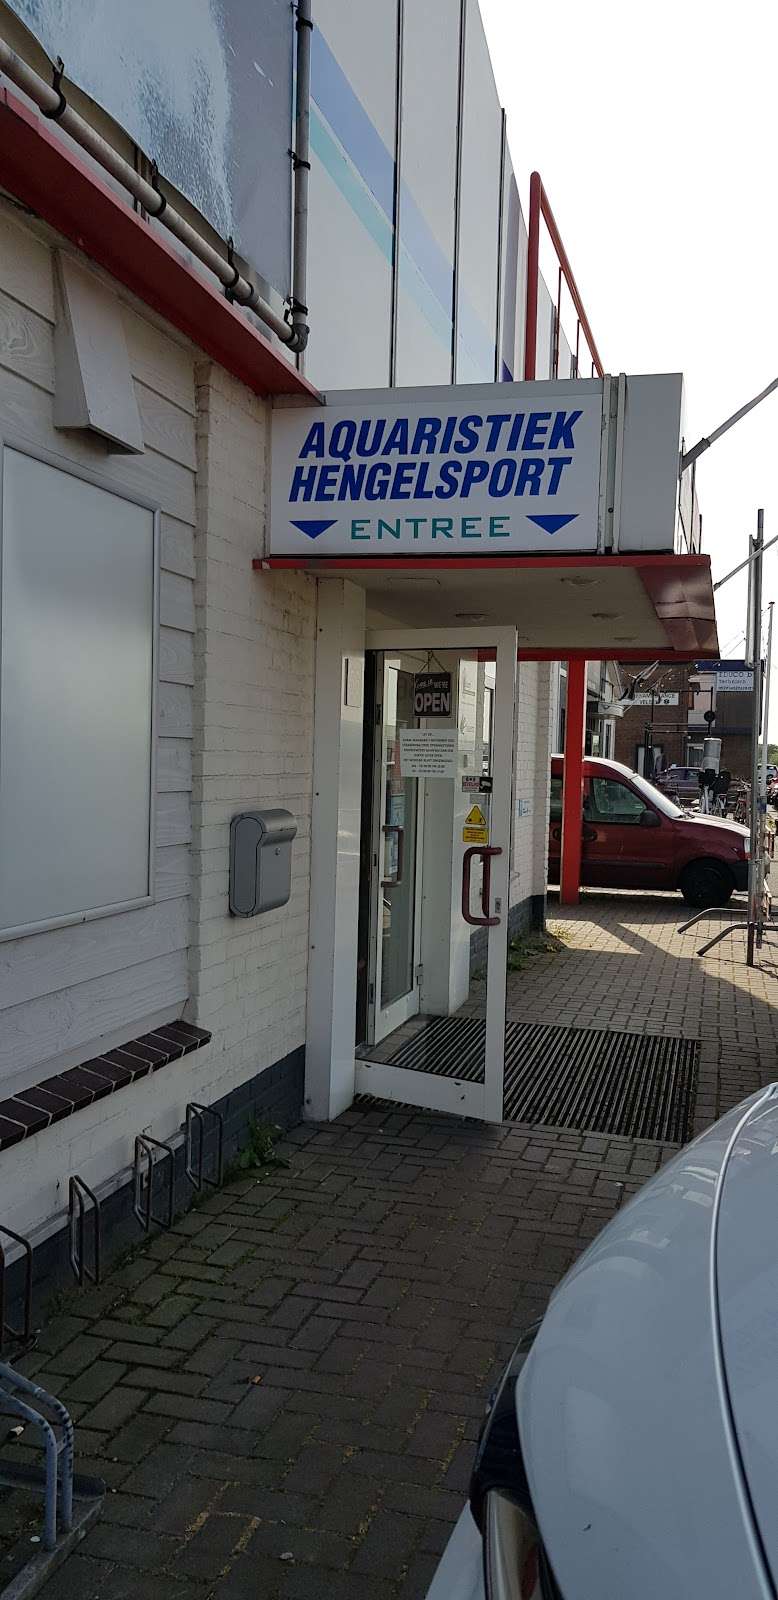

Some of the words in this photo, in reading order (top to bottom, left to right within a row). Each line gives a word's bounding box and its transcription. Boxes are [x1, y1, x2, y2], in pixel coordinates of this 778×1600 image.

[298, 410, 583, 462] AQUARISTIEK
[288, 456, 572, 502] HENGELSPORT
[350, 516, 511, 540] ENTREE
[415, 692, 450, 712] OPEN
